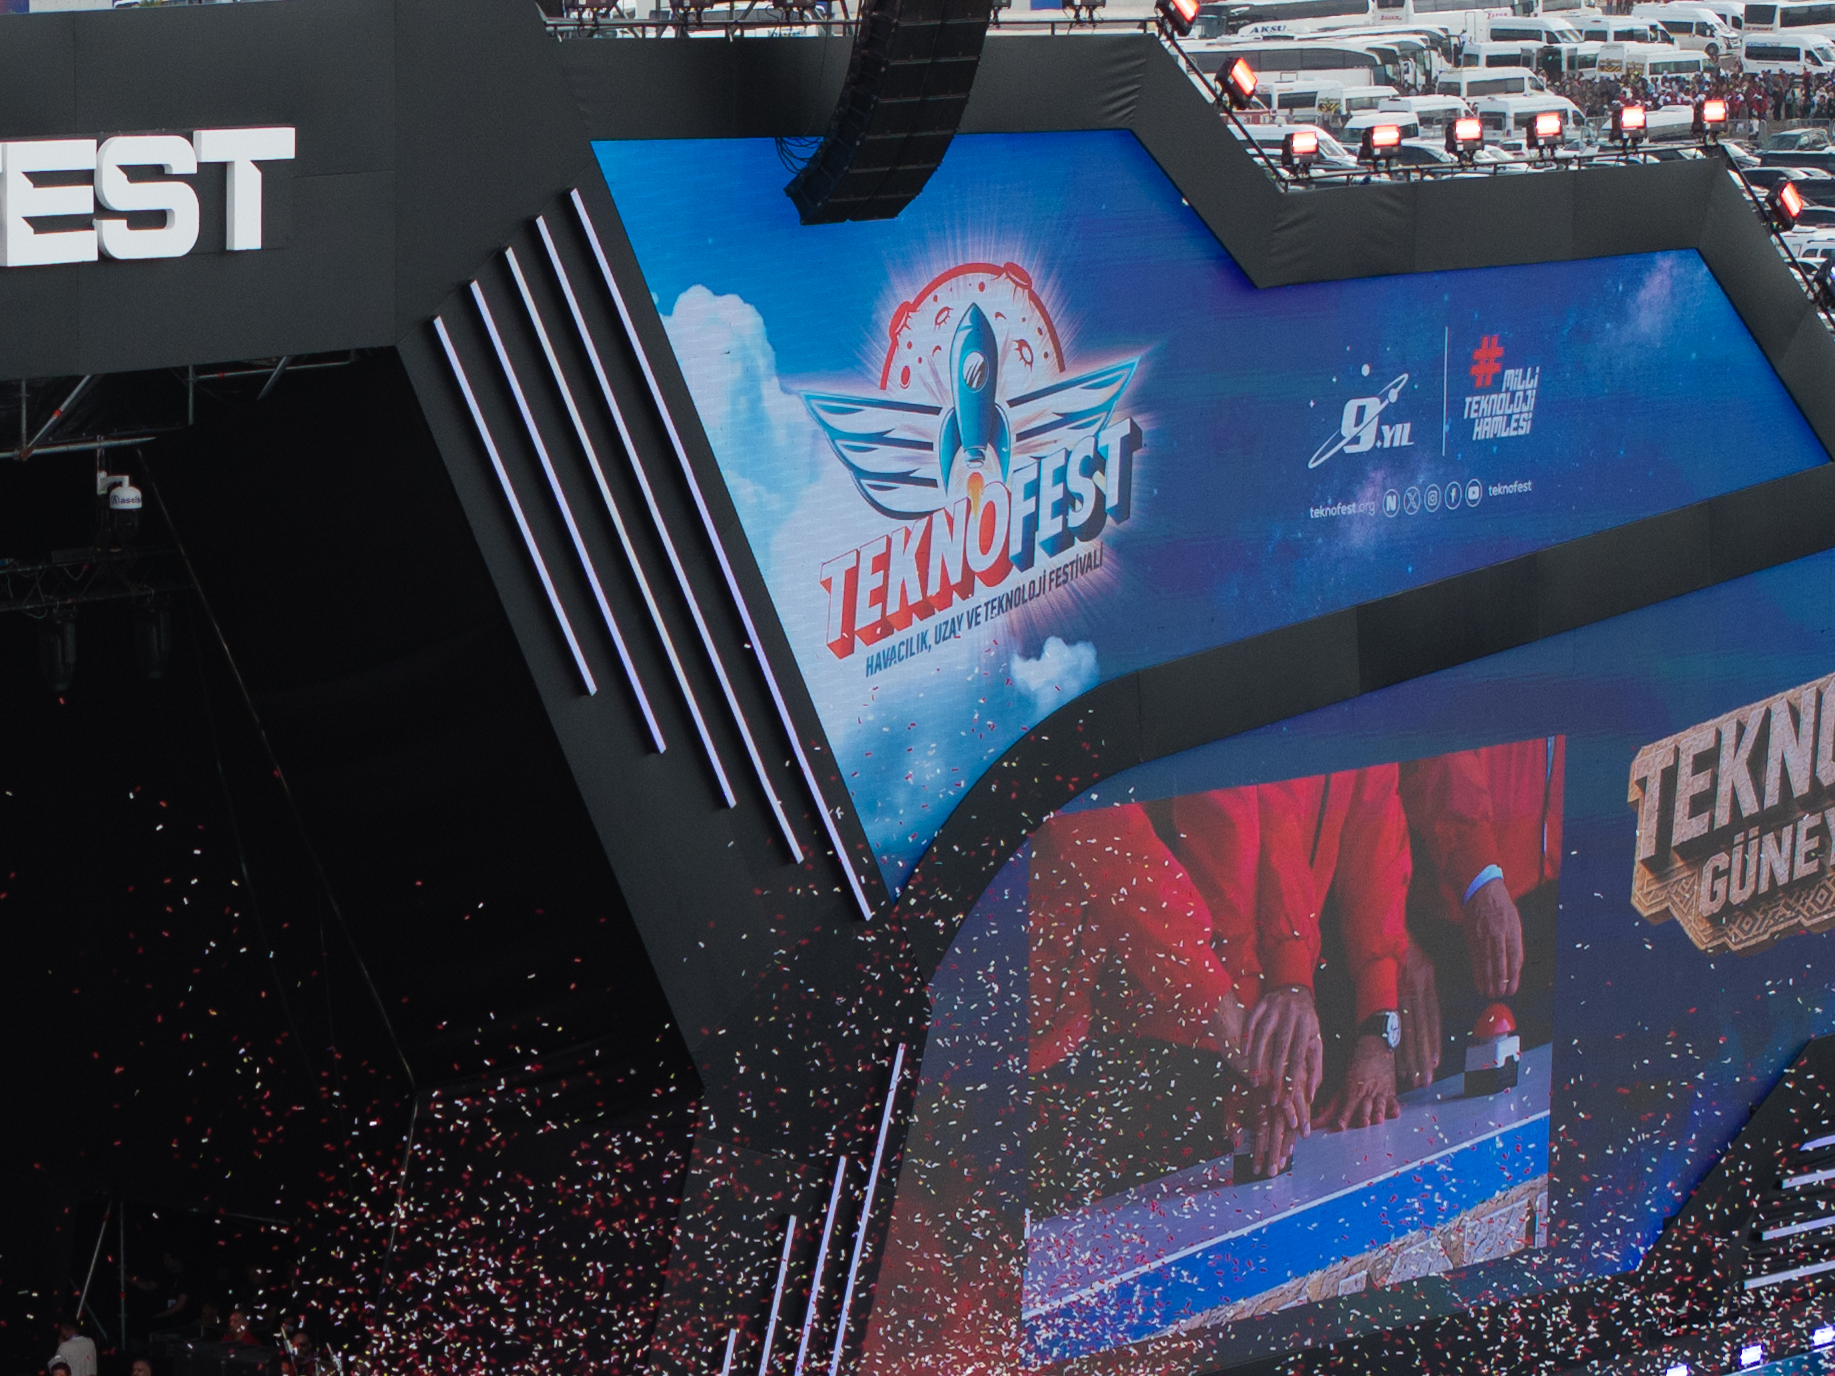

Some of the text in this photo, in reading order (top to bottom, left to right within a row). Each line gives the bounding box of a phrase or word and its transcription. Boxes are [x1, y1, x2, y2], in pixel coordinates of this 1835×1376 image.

[1463, 388, 1536, 419] TEKNOLOJİ
[1472, 416, 1533, 441] HAMLESİ
[1488, 479, 1533, 498] teknofest
[1309, 498, 1376, 519] teknofest.org
[820, 417, 1143, 660] TEKNOFEST
[933, 614, 965, 645] UZAY
[966, 605, 983, 630] VE
[983, 569, 1048, 620] TEKNOLOJİ
[1048, 541, 1105, 591] FESTİVALİ
